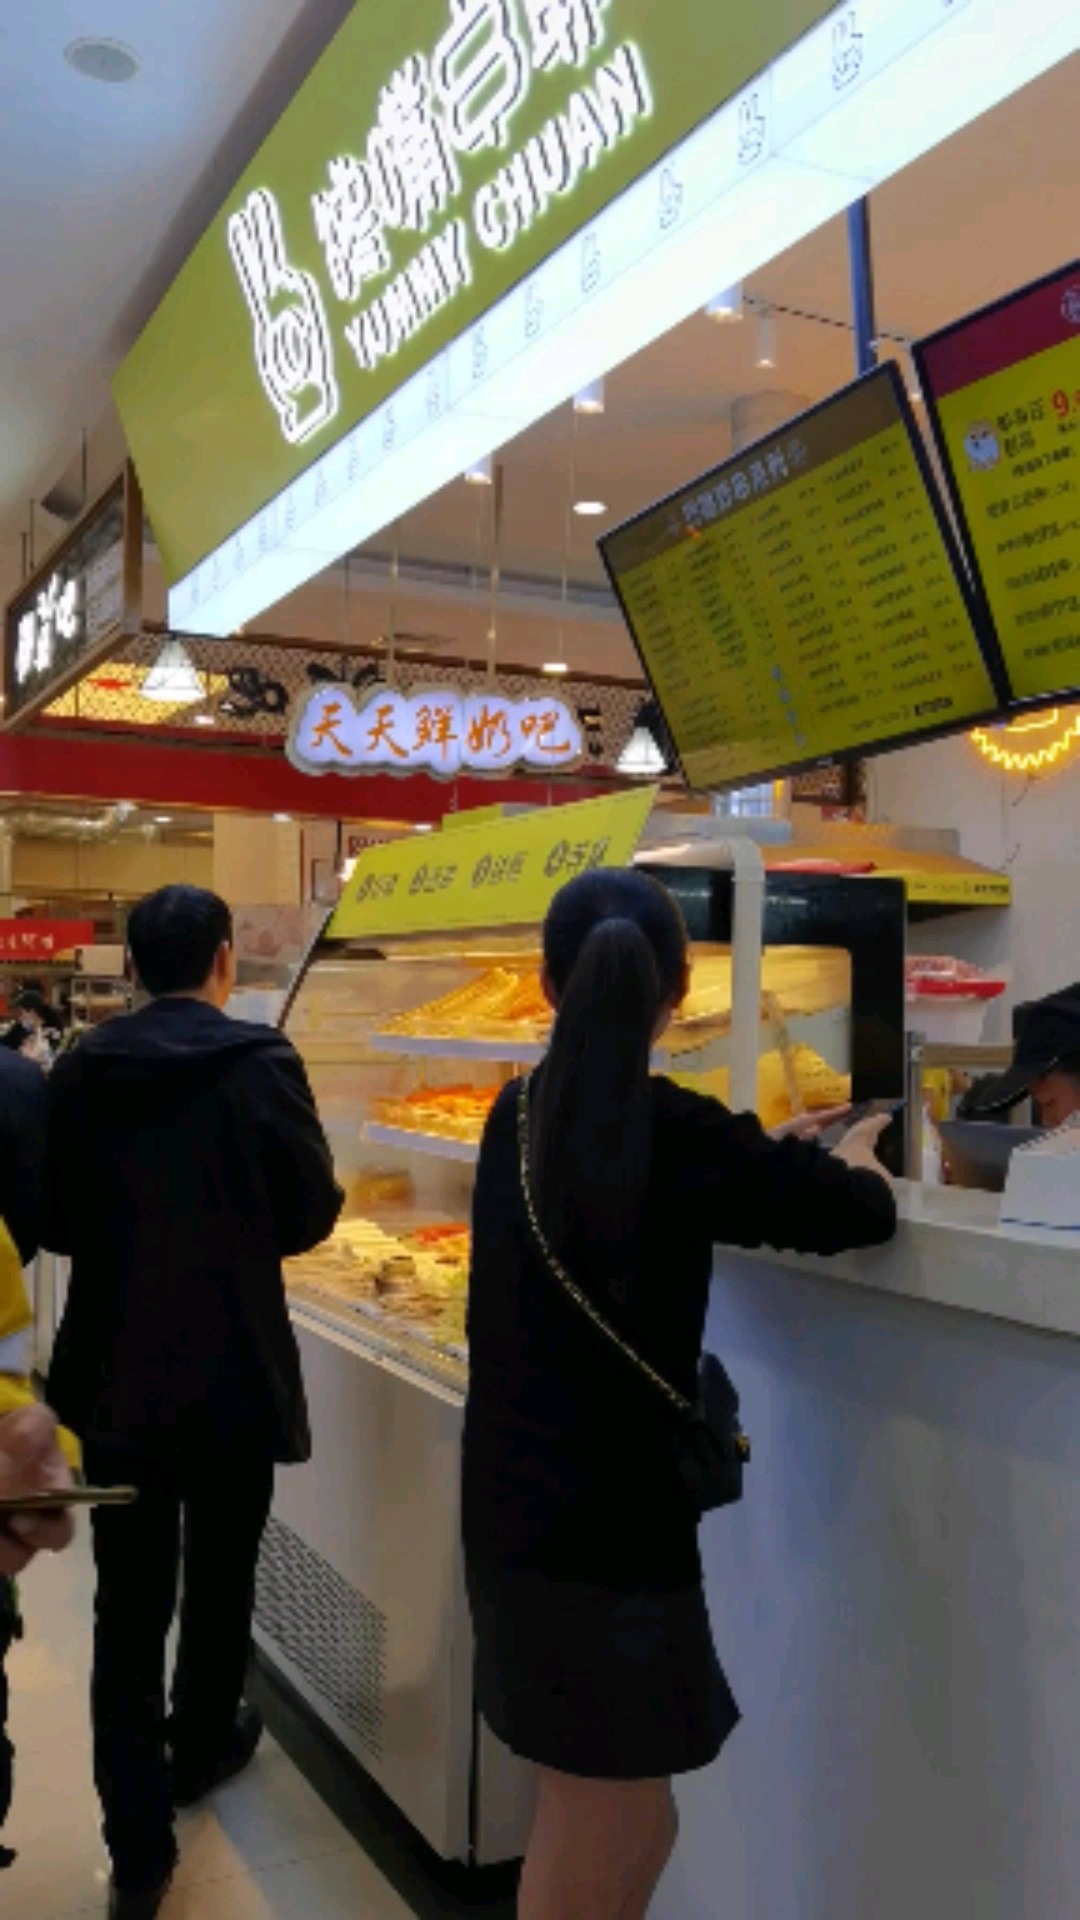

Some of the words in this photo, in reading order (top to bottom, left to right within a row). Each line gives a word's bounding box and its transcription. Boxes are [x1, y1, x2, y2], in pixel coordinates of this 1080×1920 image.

[345, 217, 471, 370] YUMMY
[473, 42, 652, 250] CHUAN
[311, 701, 572, 761] 天天鲜奶吧
